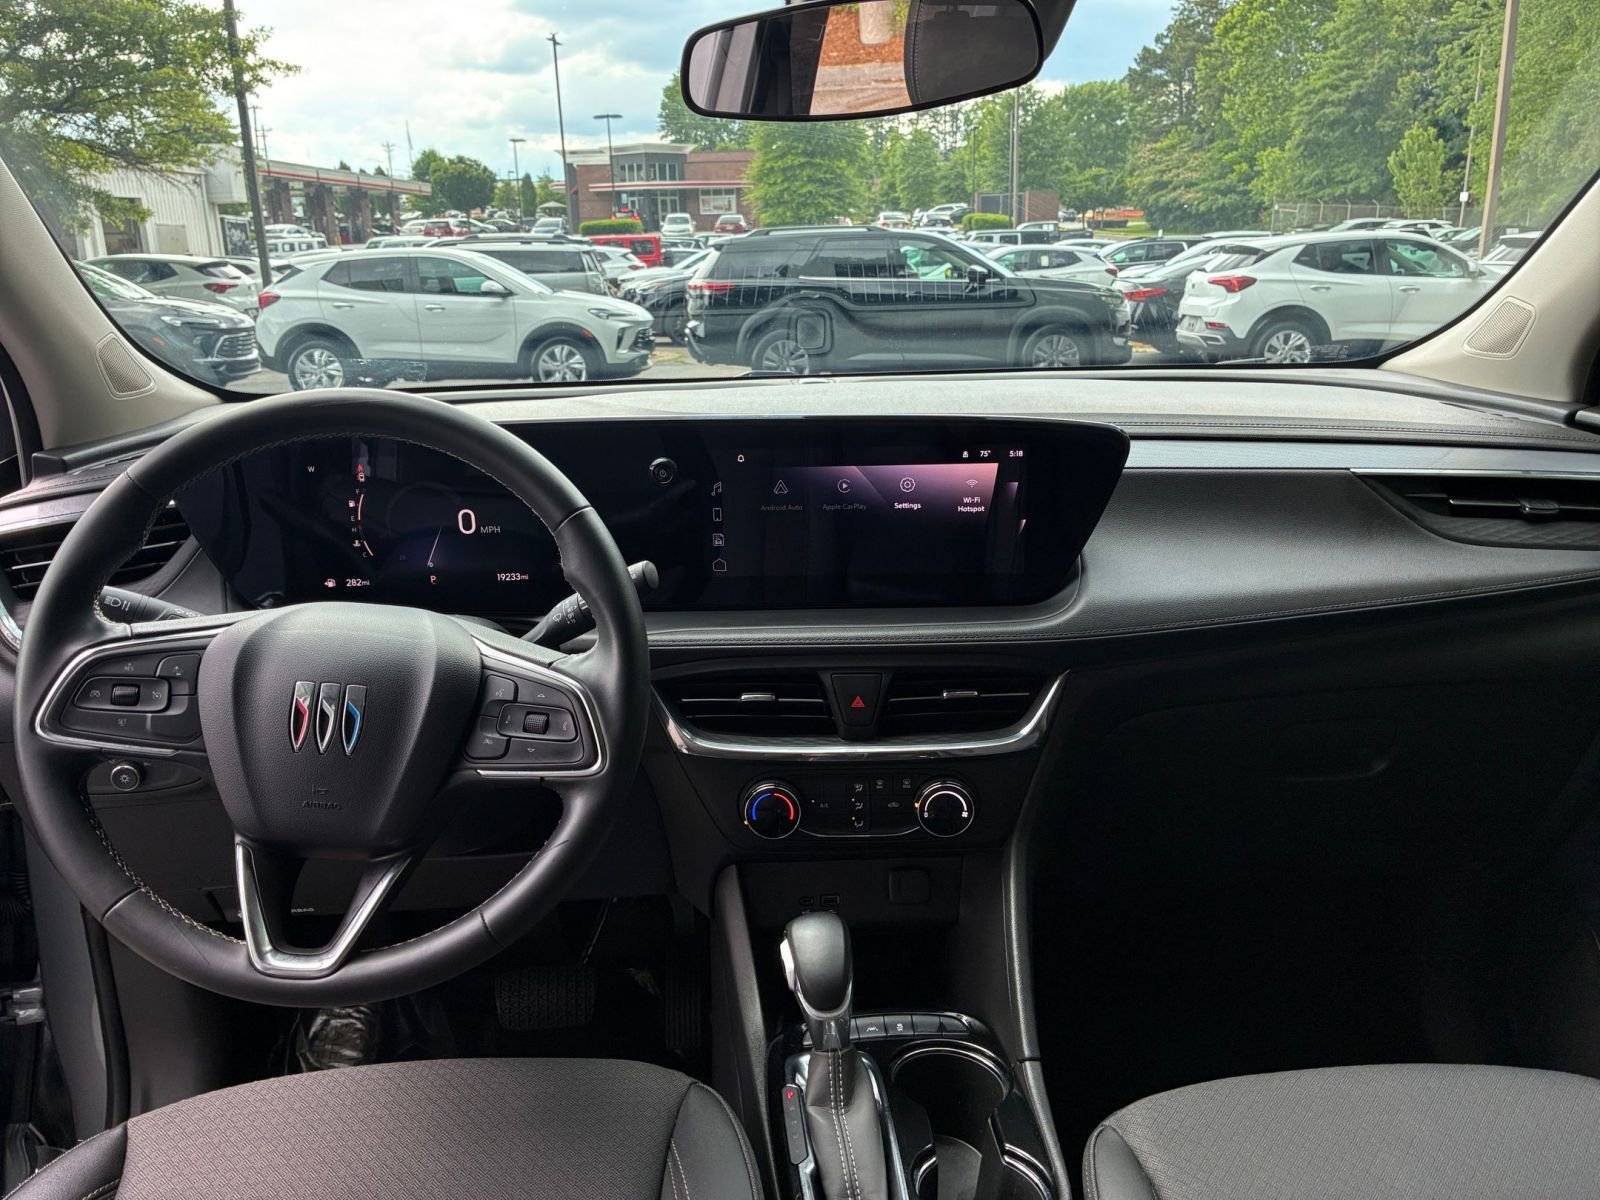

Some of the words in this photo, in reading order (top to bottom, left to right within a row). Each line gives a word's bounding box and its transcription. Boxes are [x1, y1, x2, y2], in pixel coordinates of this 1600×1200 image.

[894, 502, 921, 510] Settings
[958, 505, 985, 513] Hotspot
[457, 509, 476, 534] 0
